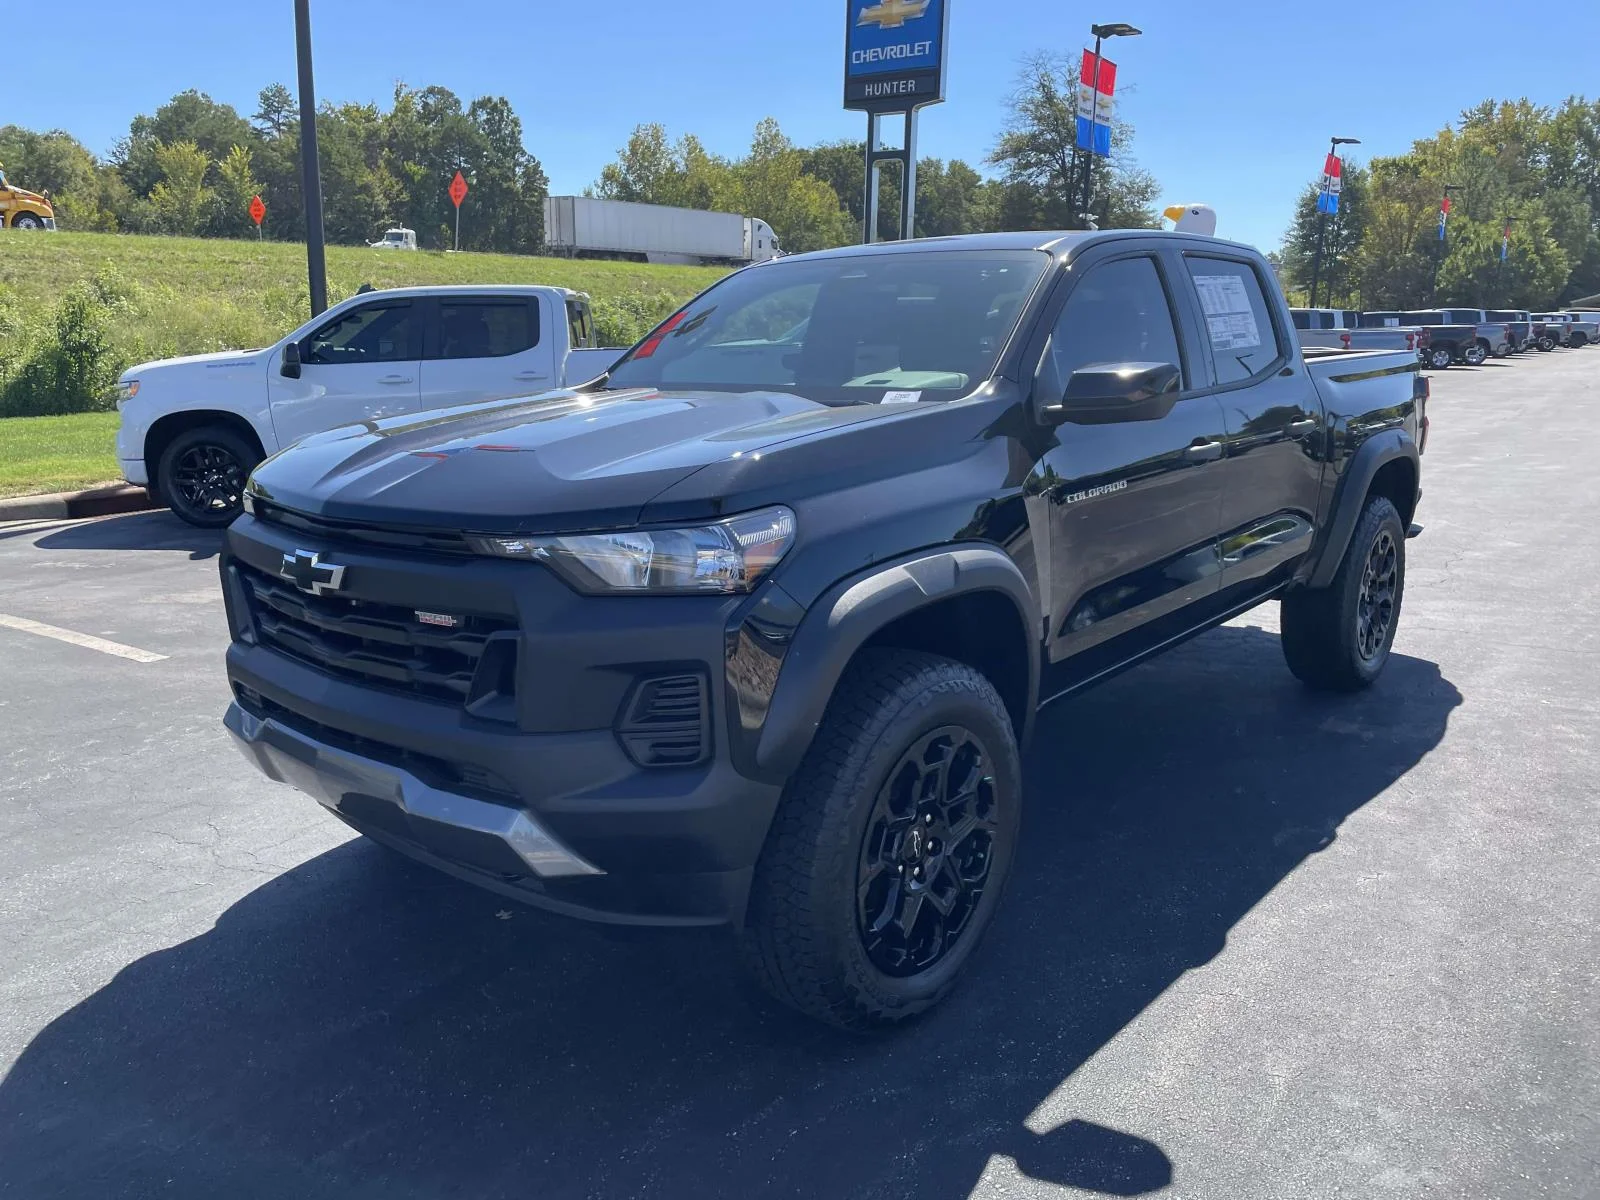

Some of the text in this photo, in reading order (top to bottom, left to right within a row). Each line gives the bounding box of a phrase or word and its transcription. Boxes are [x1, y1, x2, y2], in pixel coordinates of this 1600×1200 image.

[852, 40, 932, 64] CHEVROLET
[865, 80, 916, 96] HUNTER
[1067, 480, 1128, 504] COLORADO
